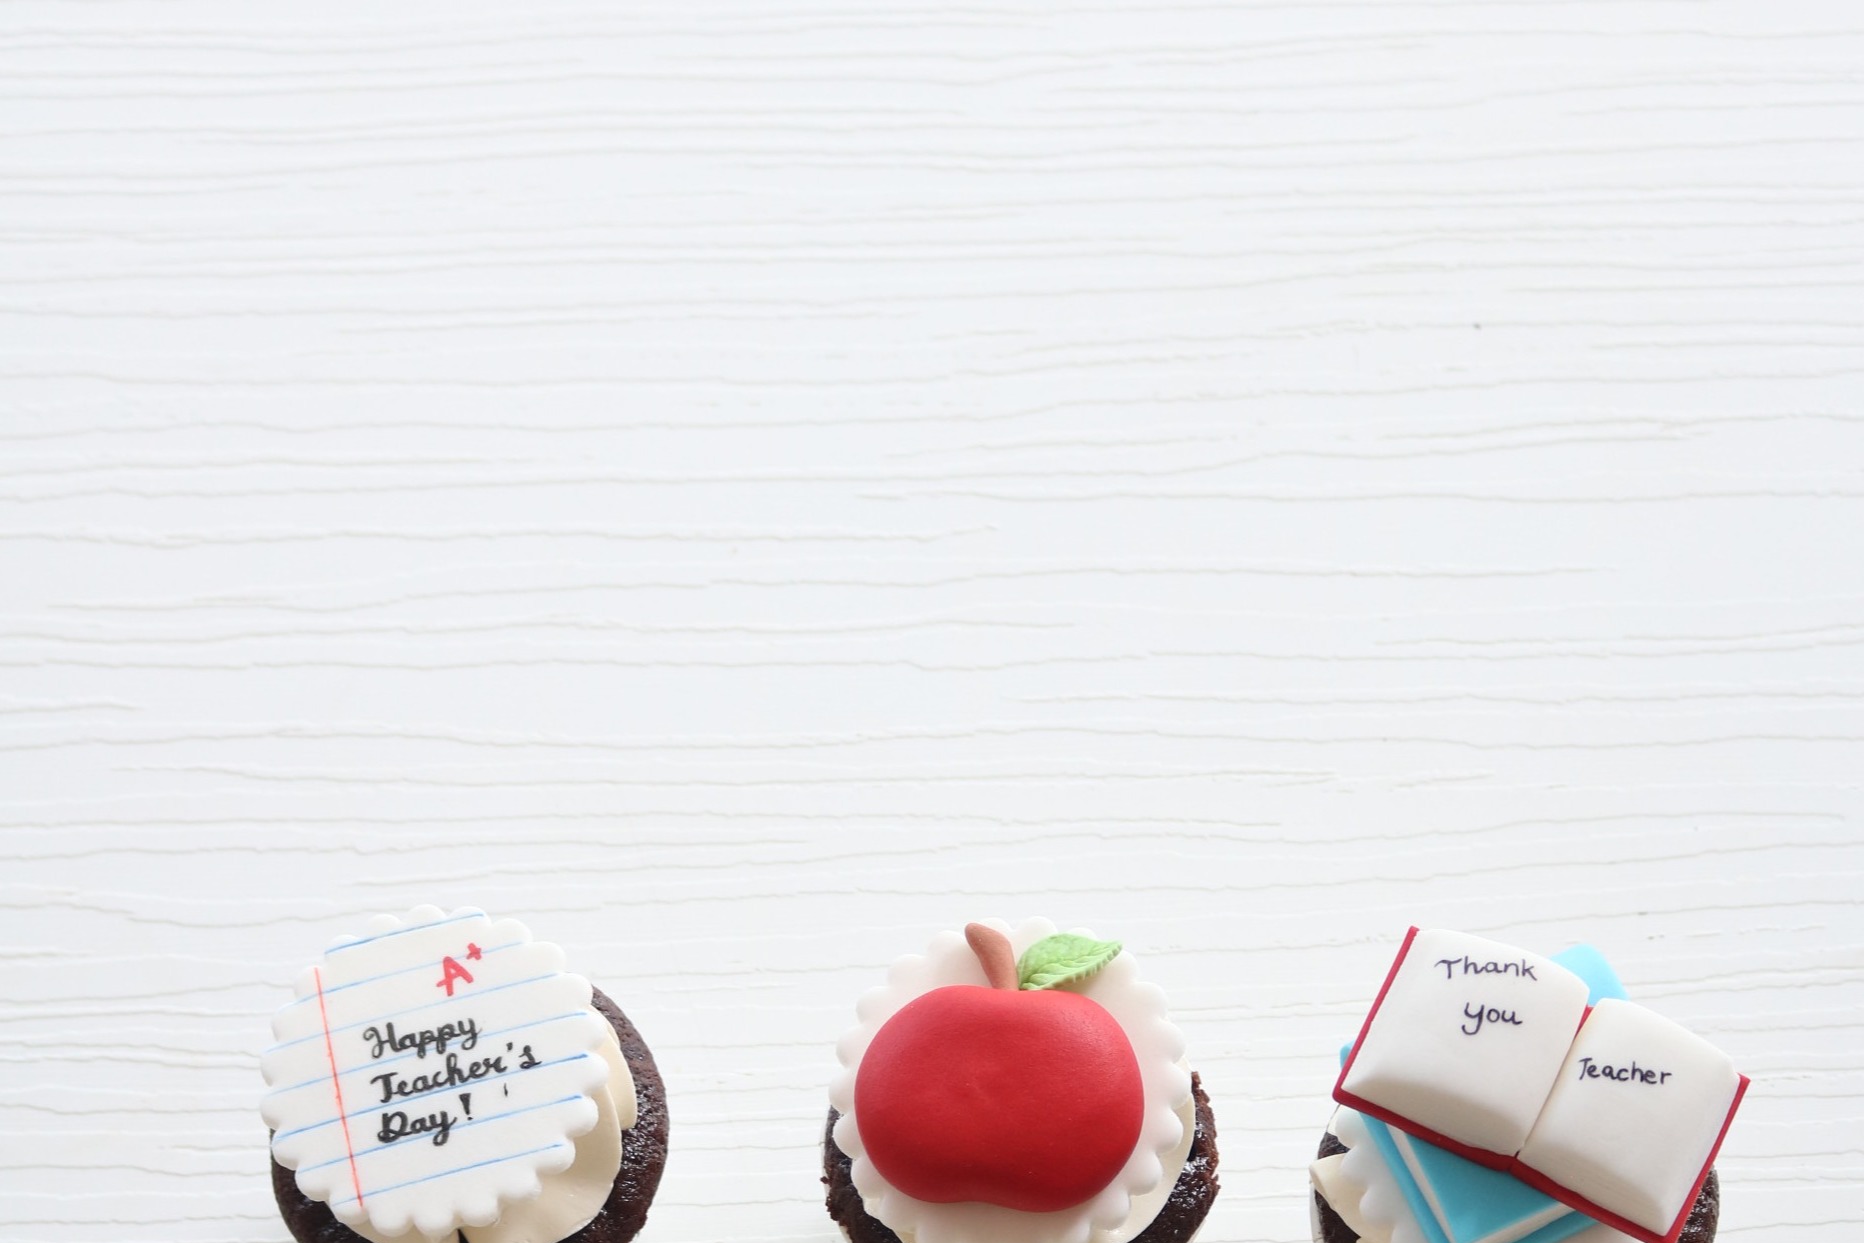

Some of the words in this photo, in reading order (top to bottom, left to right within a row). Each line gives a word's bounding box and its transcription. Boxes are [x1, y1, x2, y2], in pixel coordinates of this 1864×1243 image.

[1434, 955, 1537, 981] Thank
[363, 1018, 482, 1059] Happy
[370, 1042, 542, 1103] Teacher's
[1578, 1057, 1672, 1085] Teacher
[377, 1092, 474, 1146] Day!
